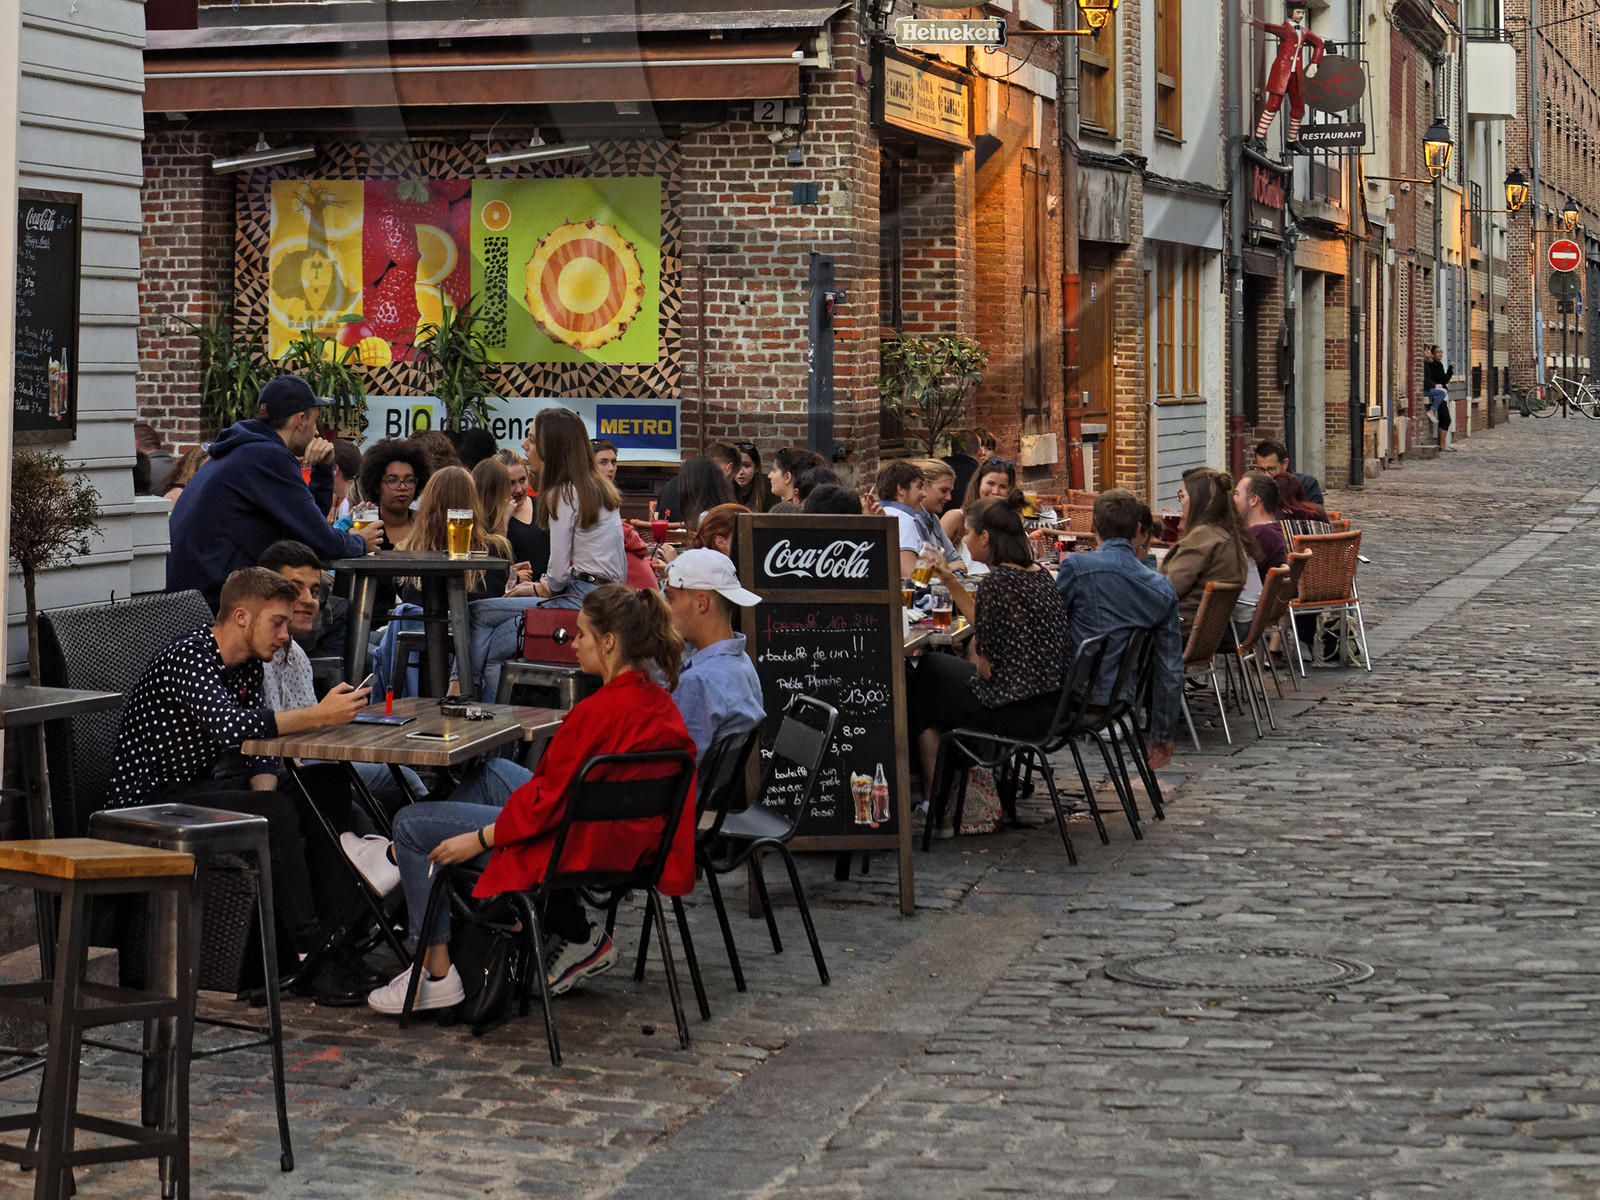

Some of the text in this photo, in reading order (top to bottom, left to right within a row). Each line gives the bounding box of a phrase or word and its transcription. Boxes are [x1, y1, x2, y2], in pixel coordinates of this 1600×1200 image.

[902, 22, 1001, 41] Heineken
[761, 102, 775, 120] 2
[1302, 131, 1362, 140] RESTAURANT
[25, 206, 56, 231] Coca-Cola
[386, 406, 432, 439] BIO
[600, 418, 673, 435] METRO
[764, 539, 875, 580] Coca-Cola
[812, 646, 827, 661] de
[829, 650, 850, 660] vin
[842, 687, 885, 707] 13,00
[842, 725, 867, 738] 8,00
[830, 742, 854, 756] 5,00
